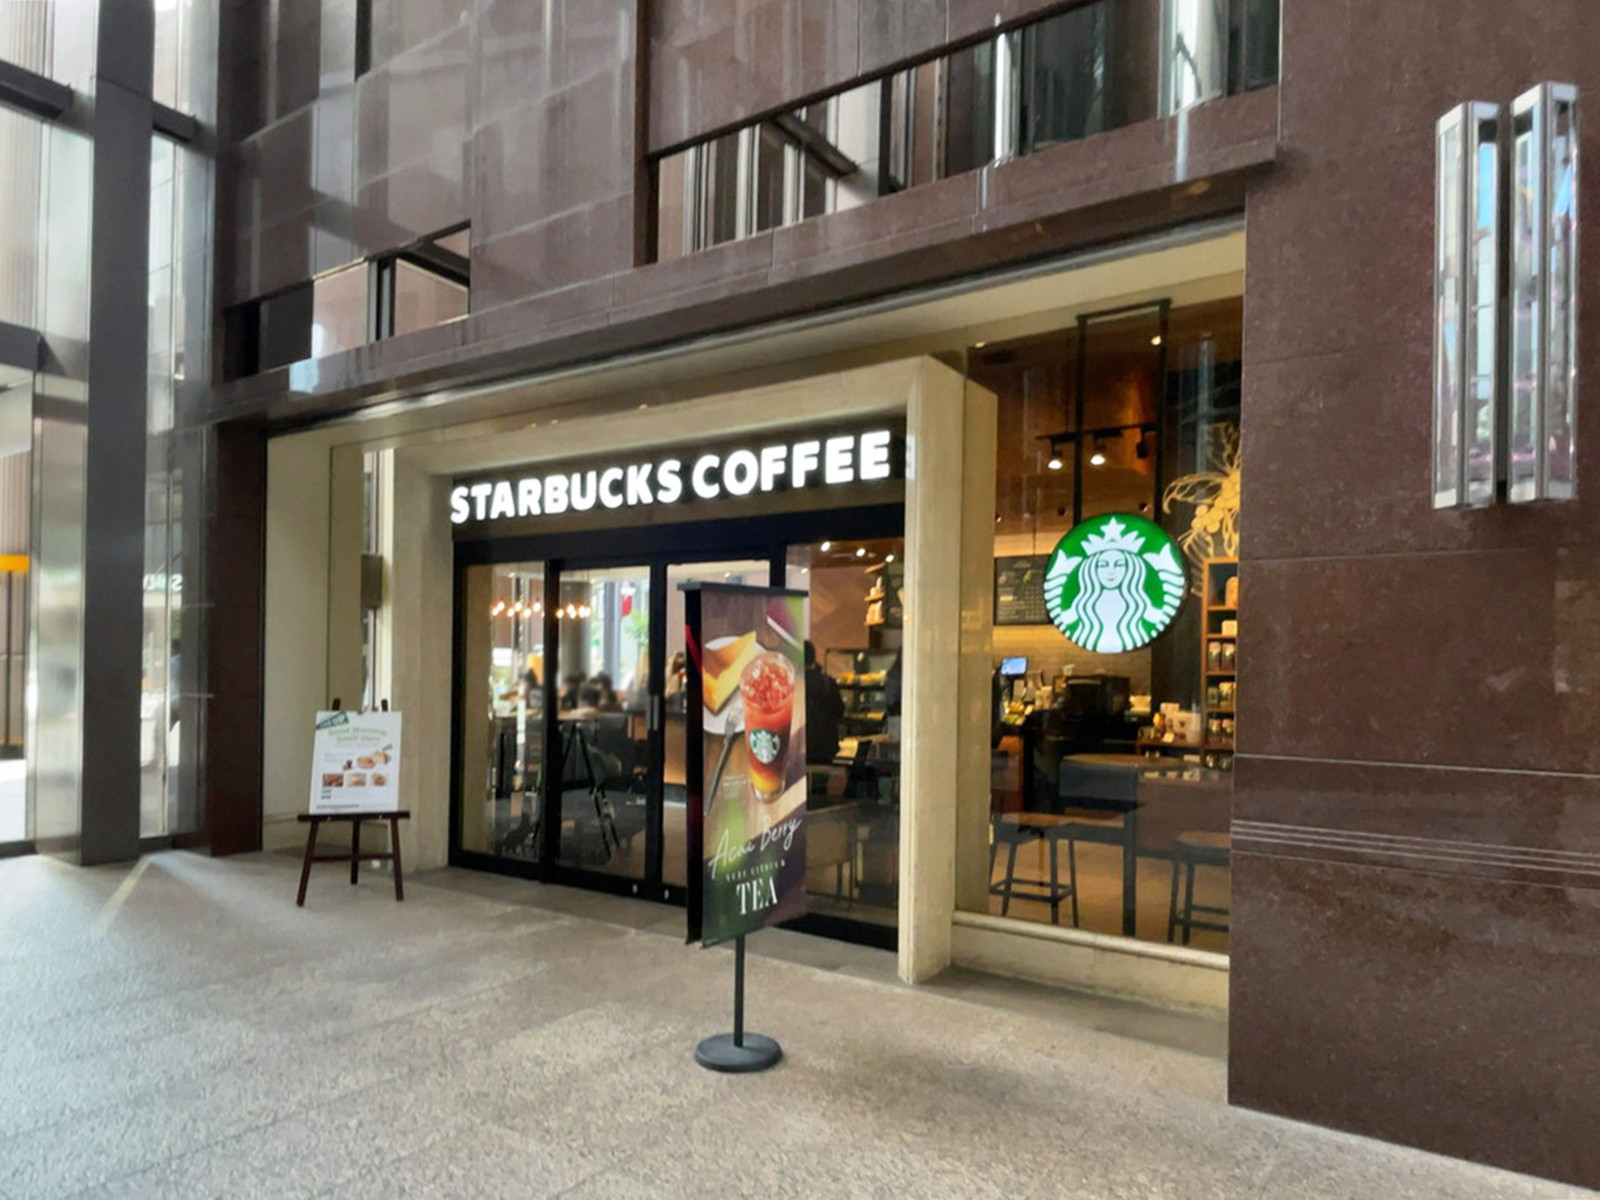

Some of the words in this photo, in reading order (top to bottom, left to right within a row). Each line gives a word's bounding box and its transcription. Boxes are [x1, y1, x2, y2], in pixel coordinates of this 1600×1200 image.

[449, 458, 683, 524] STARBUCKS
[691, 430, 892, 500] COFFEE
[760, 815, 802, 852] Berry
[736, 875, 778, 916] TEA
